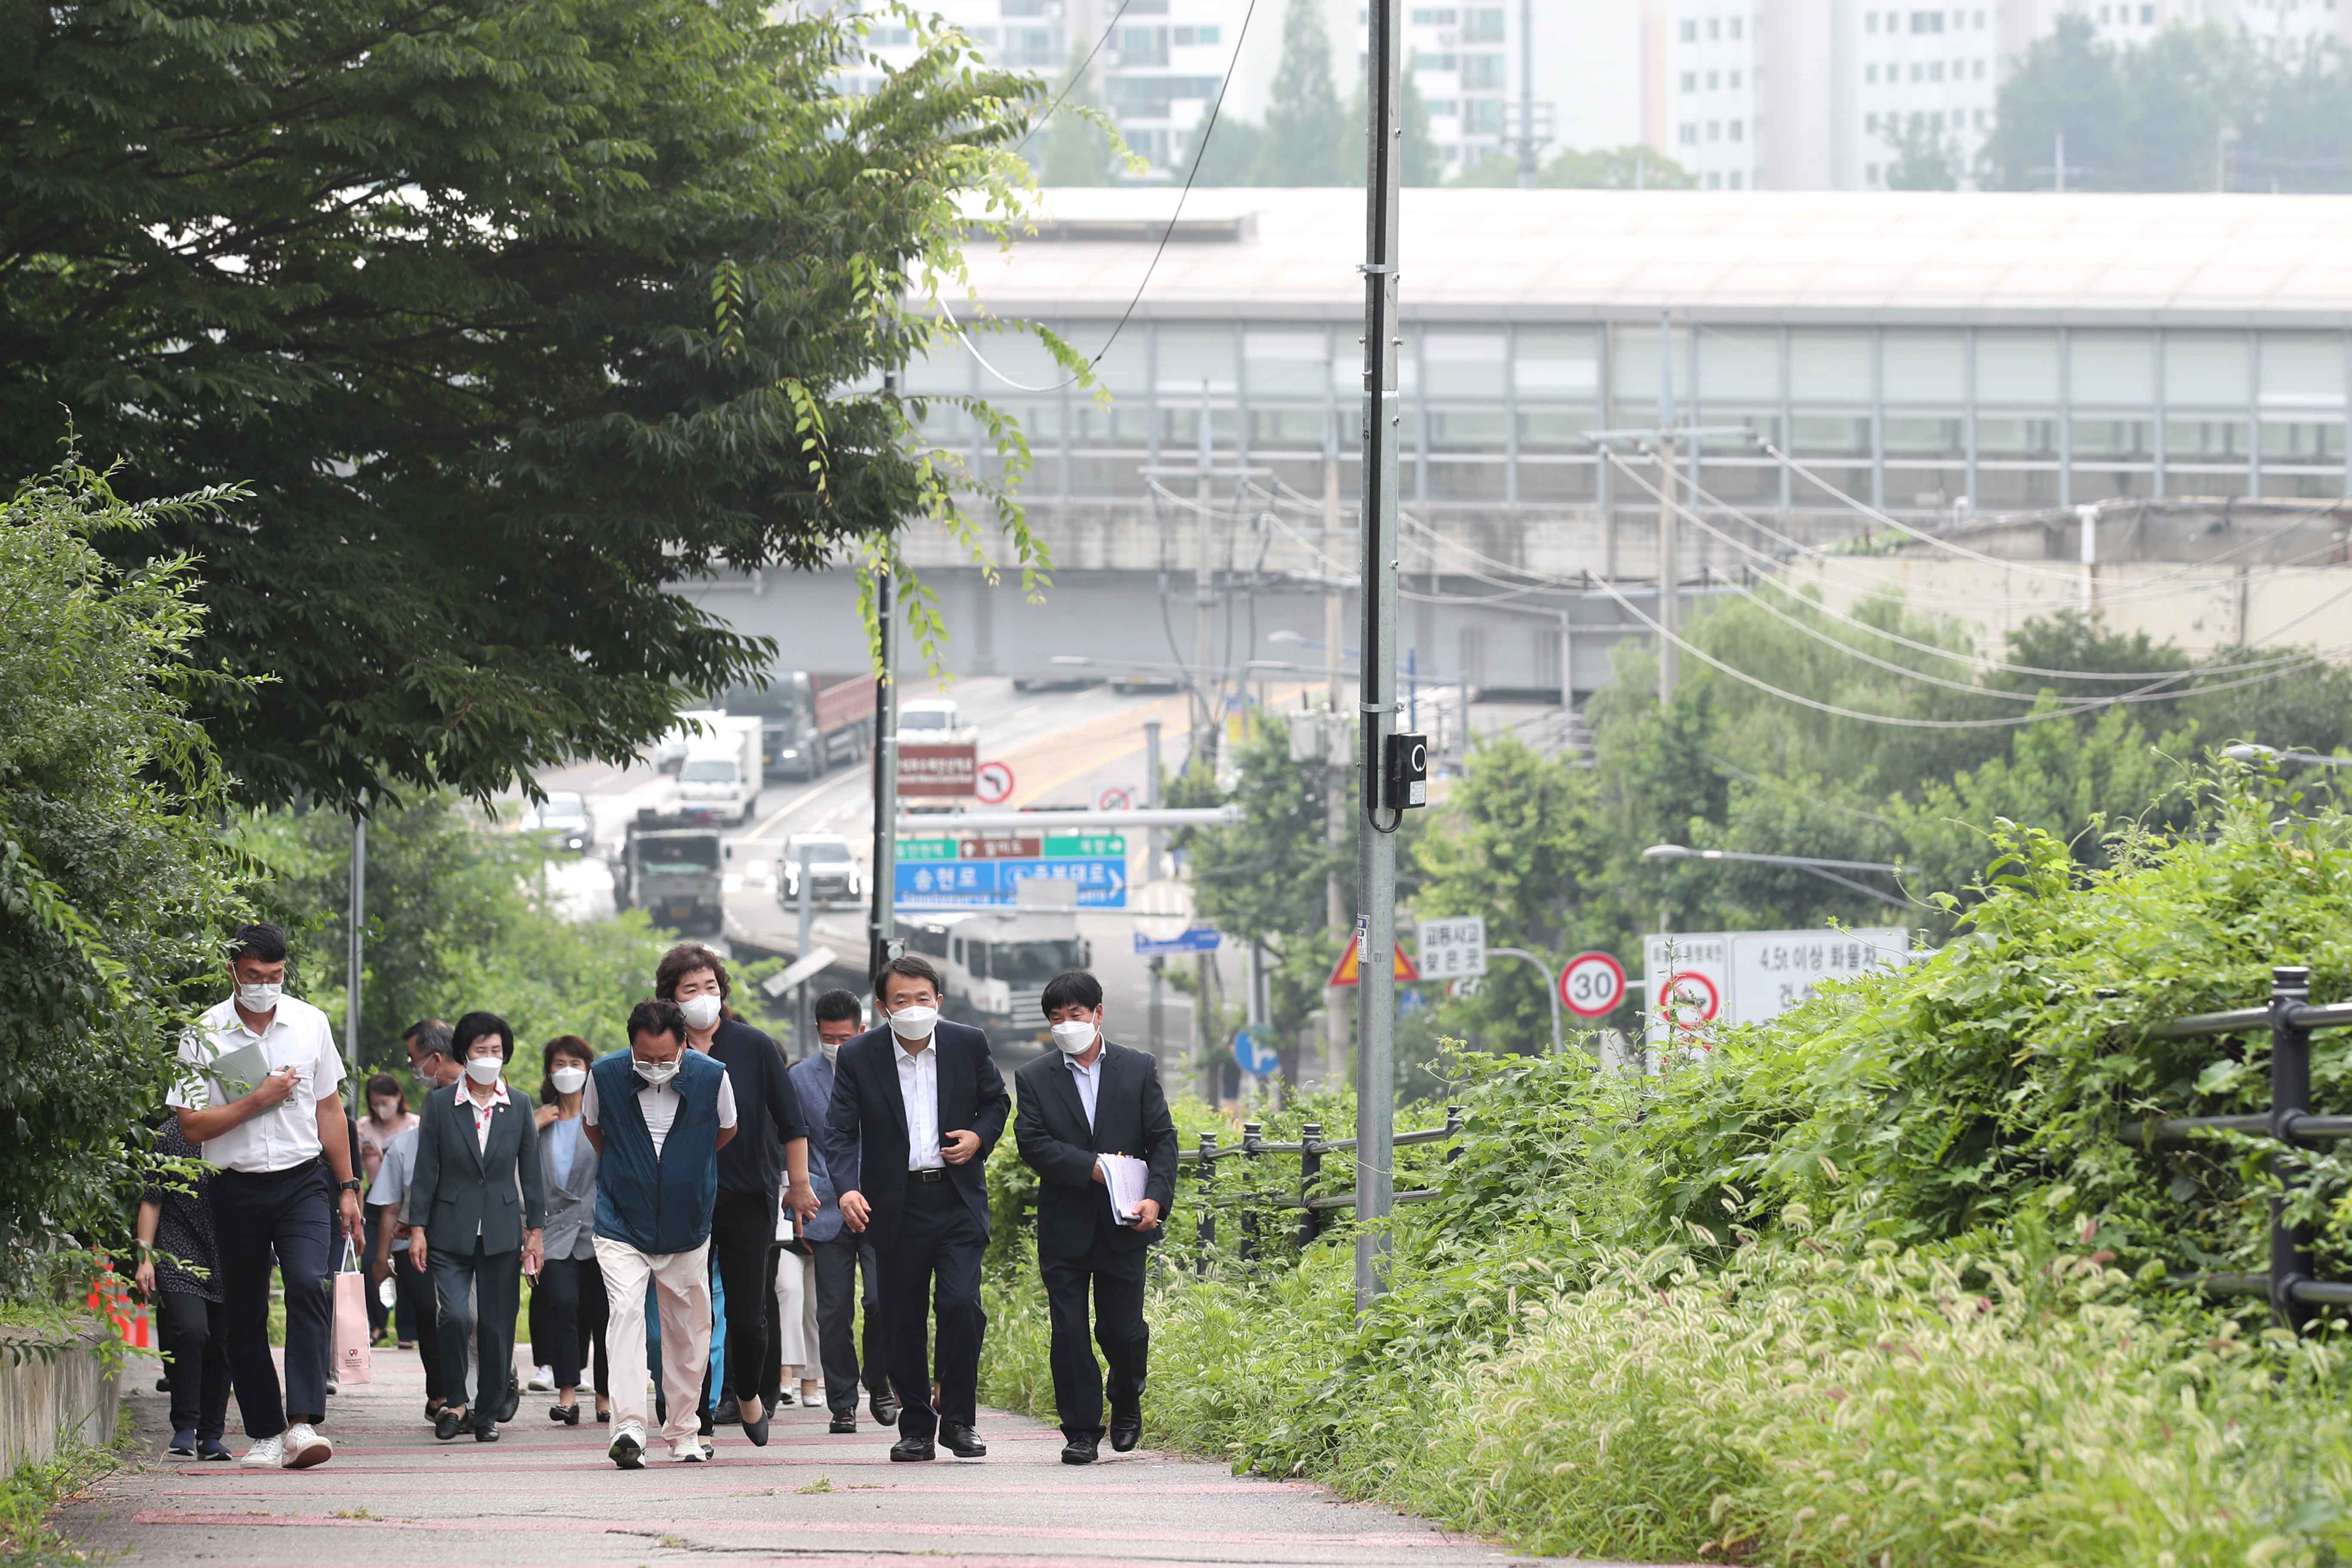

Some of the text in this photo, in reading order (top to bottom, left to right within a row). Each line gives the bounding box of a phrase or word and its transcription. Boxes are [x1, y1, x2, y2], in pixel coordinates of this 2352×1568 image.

[913, 867, 977, 891] 송현로
[1426, 925, 1479, 946] 교통사고
[1760, 943, 1876, 971] 4.5t 이상 화물차
[1575, 972, 1611, 999] 30
